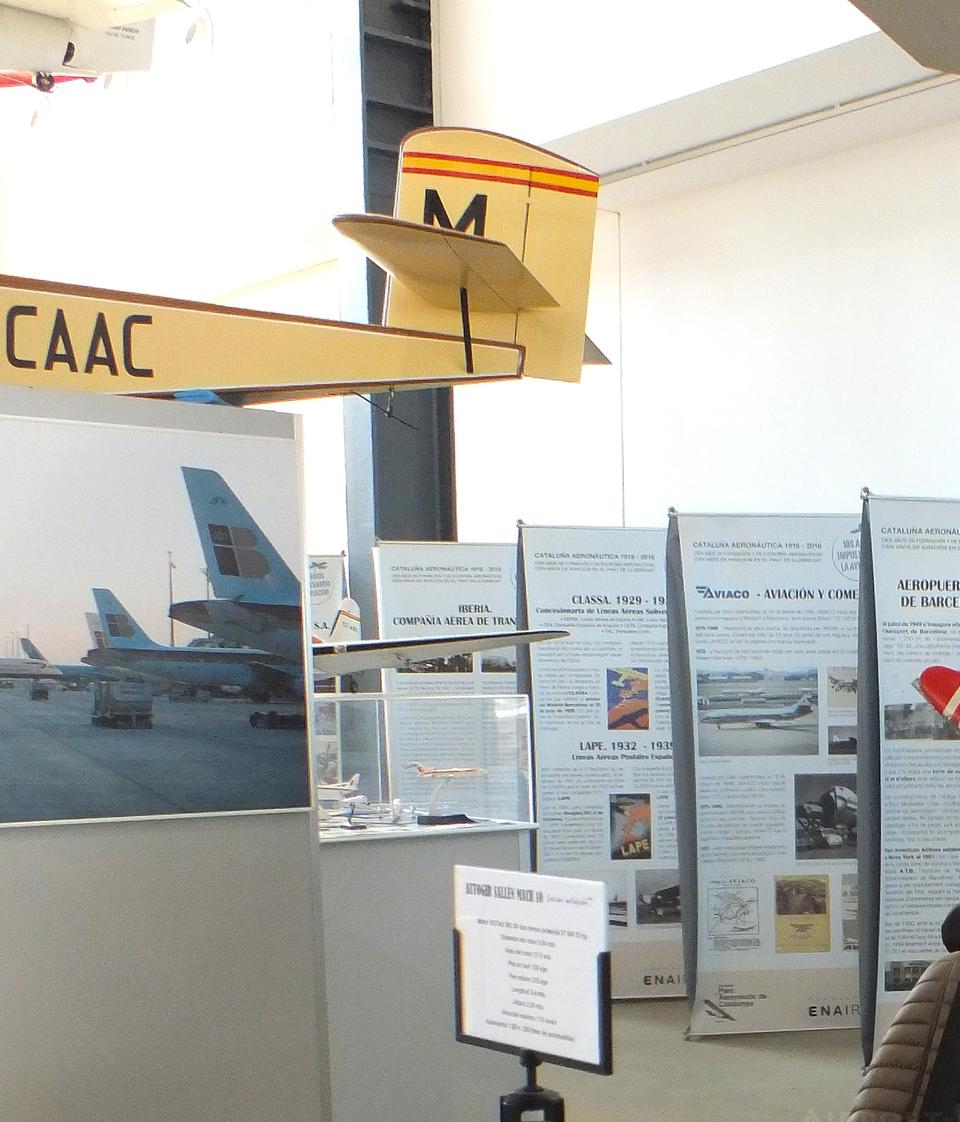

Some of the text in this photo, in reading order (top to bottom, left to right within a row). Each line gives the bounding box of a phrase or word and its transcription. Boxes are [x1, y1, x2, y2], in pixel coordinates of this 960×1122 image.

[424, 189, 488, 237] M
[6, 305, 154, 378] CAAC
[764, 587, 814, 599] AVIACIÓN
[818, 589, 824, 599] Y
[572, 595, 612, 605] CLASSA.
[616, 596, 642, 606] 1929
[901, 596, 916, 608] DE
[458, 604, 492, 613] IBERIA.
[477, 617, 489, 626] DE
[580, 742, 607, 751] LAPE.
[611, 741, 637, 751] 1932
[621, 838, 650, 857] LAPE
